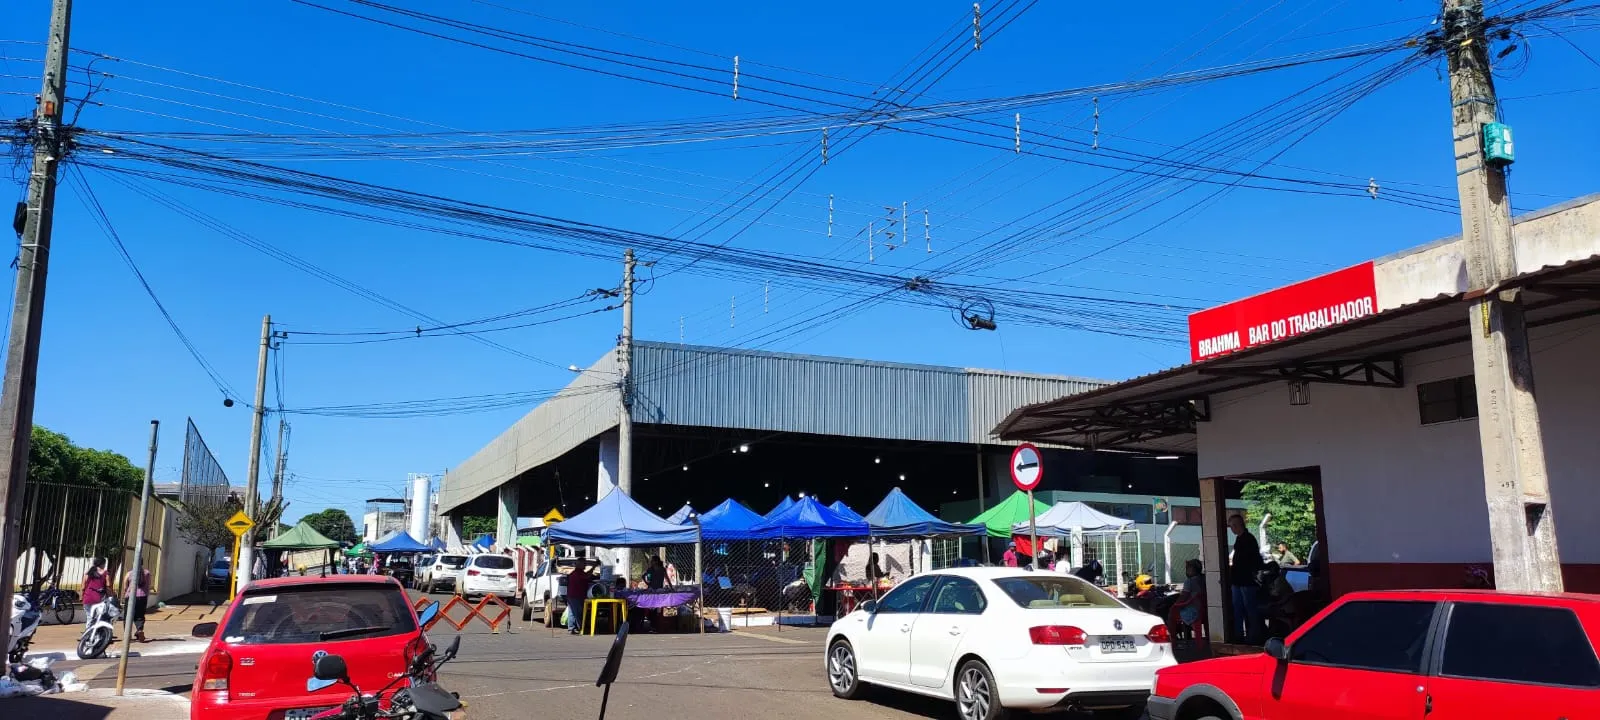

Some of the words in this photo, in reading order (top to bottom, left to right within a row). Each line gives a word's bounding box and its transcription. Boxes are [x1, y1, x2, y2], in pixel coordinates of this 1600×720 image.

[1198, 331, 1241, 357] BRAHMA
[1248, 323, 1270, 345] BAR
[1271, 319, 1286, 339] DO
[1288, 296, 1373, 334] TRABALHADOR
